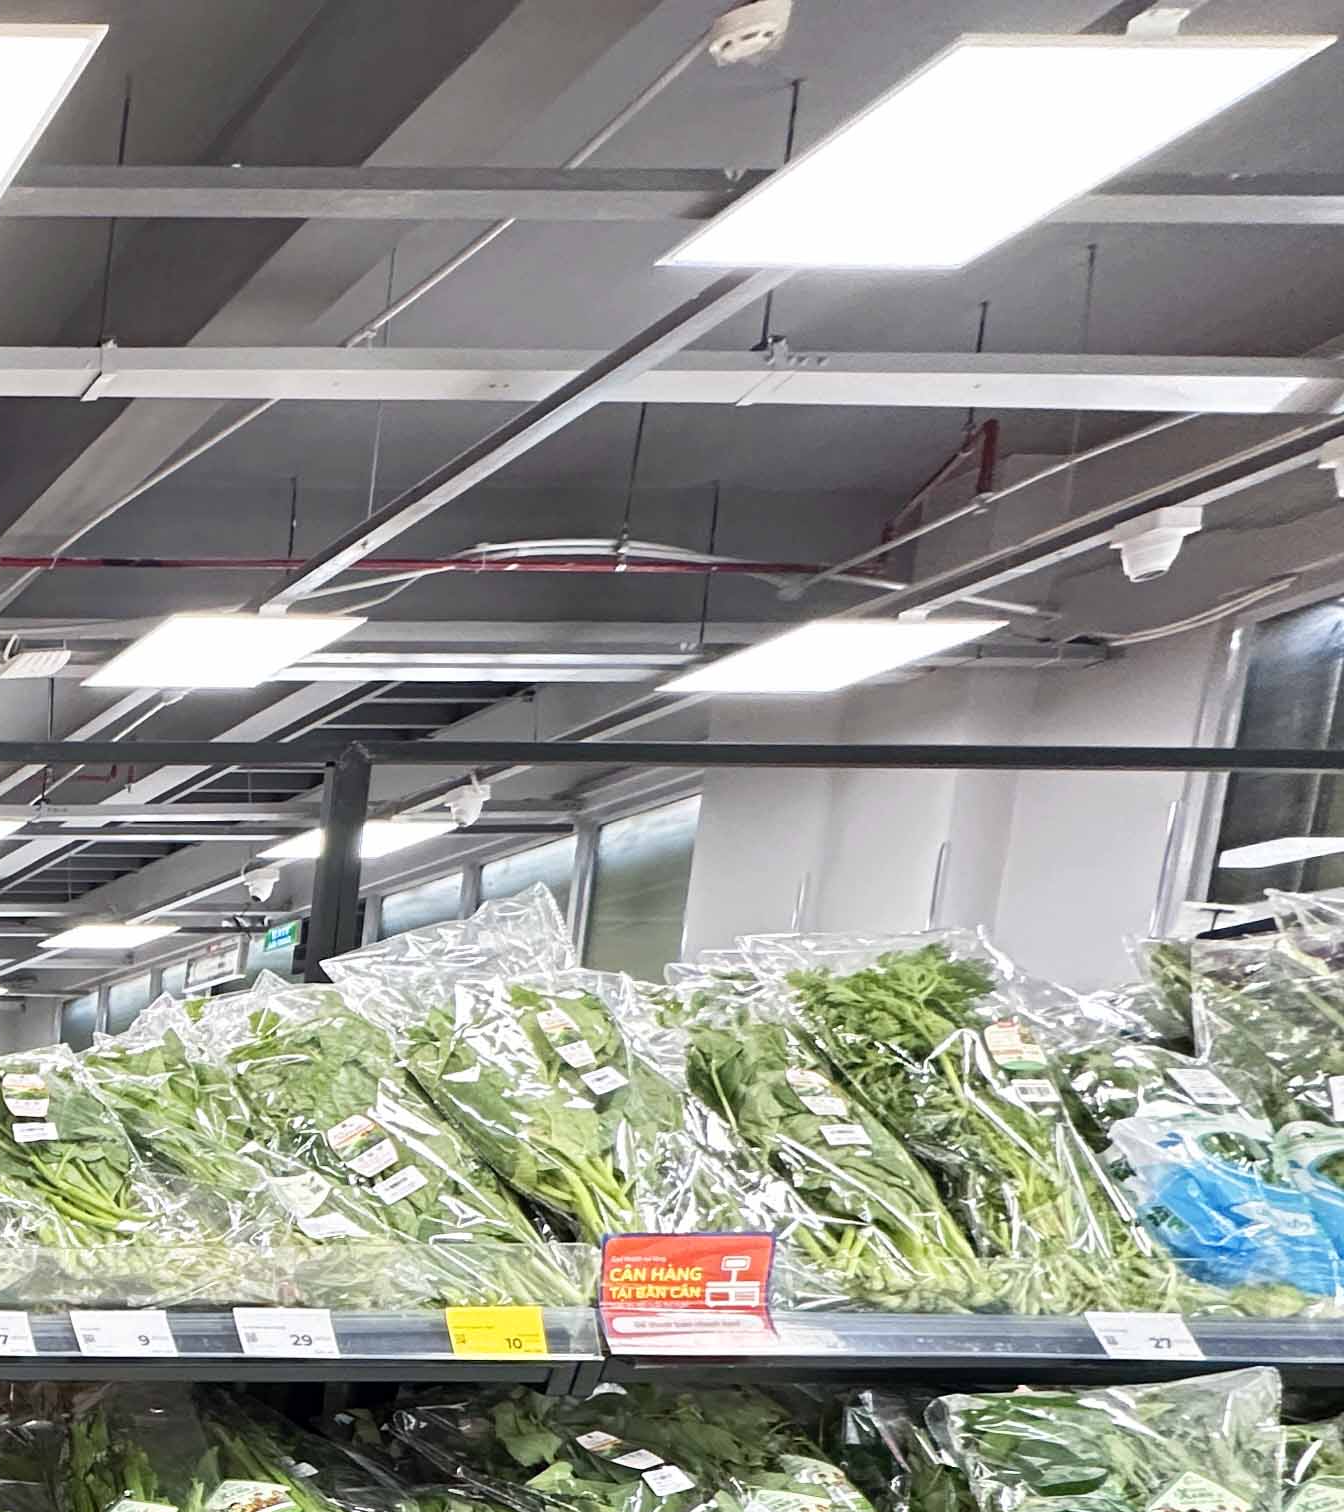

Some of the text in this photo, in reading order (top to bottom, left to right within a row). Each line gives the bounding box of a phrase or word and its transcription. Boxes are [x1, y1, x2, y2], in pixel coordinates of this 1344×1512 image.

[609, 1264, 703, 1282] CÂN HÀNG
[609, 1286, 634, 1302] TẠI
[137, 1334, 151, 1346] 9
[289, 1334, 313, 1347] 29
[504, 1337, 523, 1350] 10
[1148, 1336, 1172, 1350] 27
